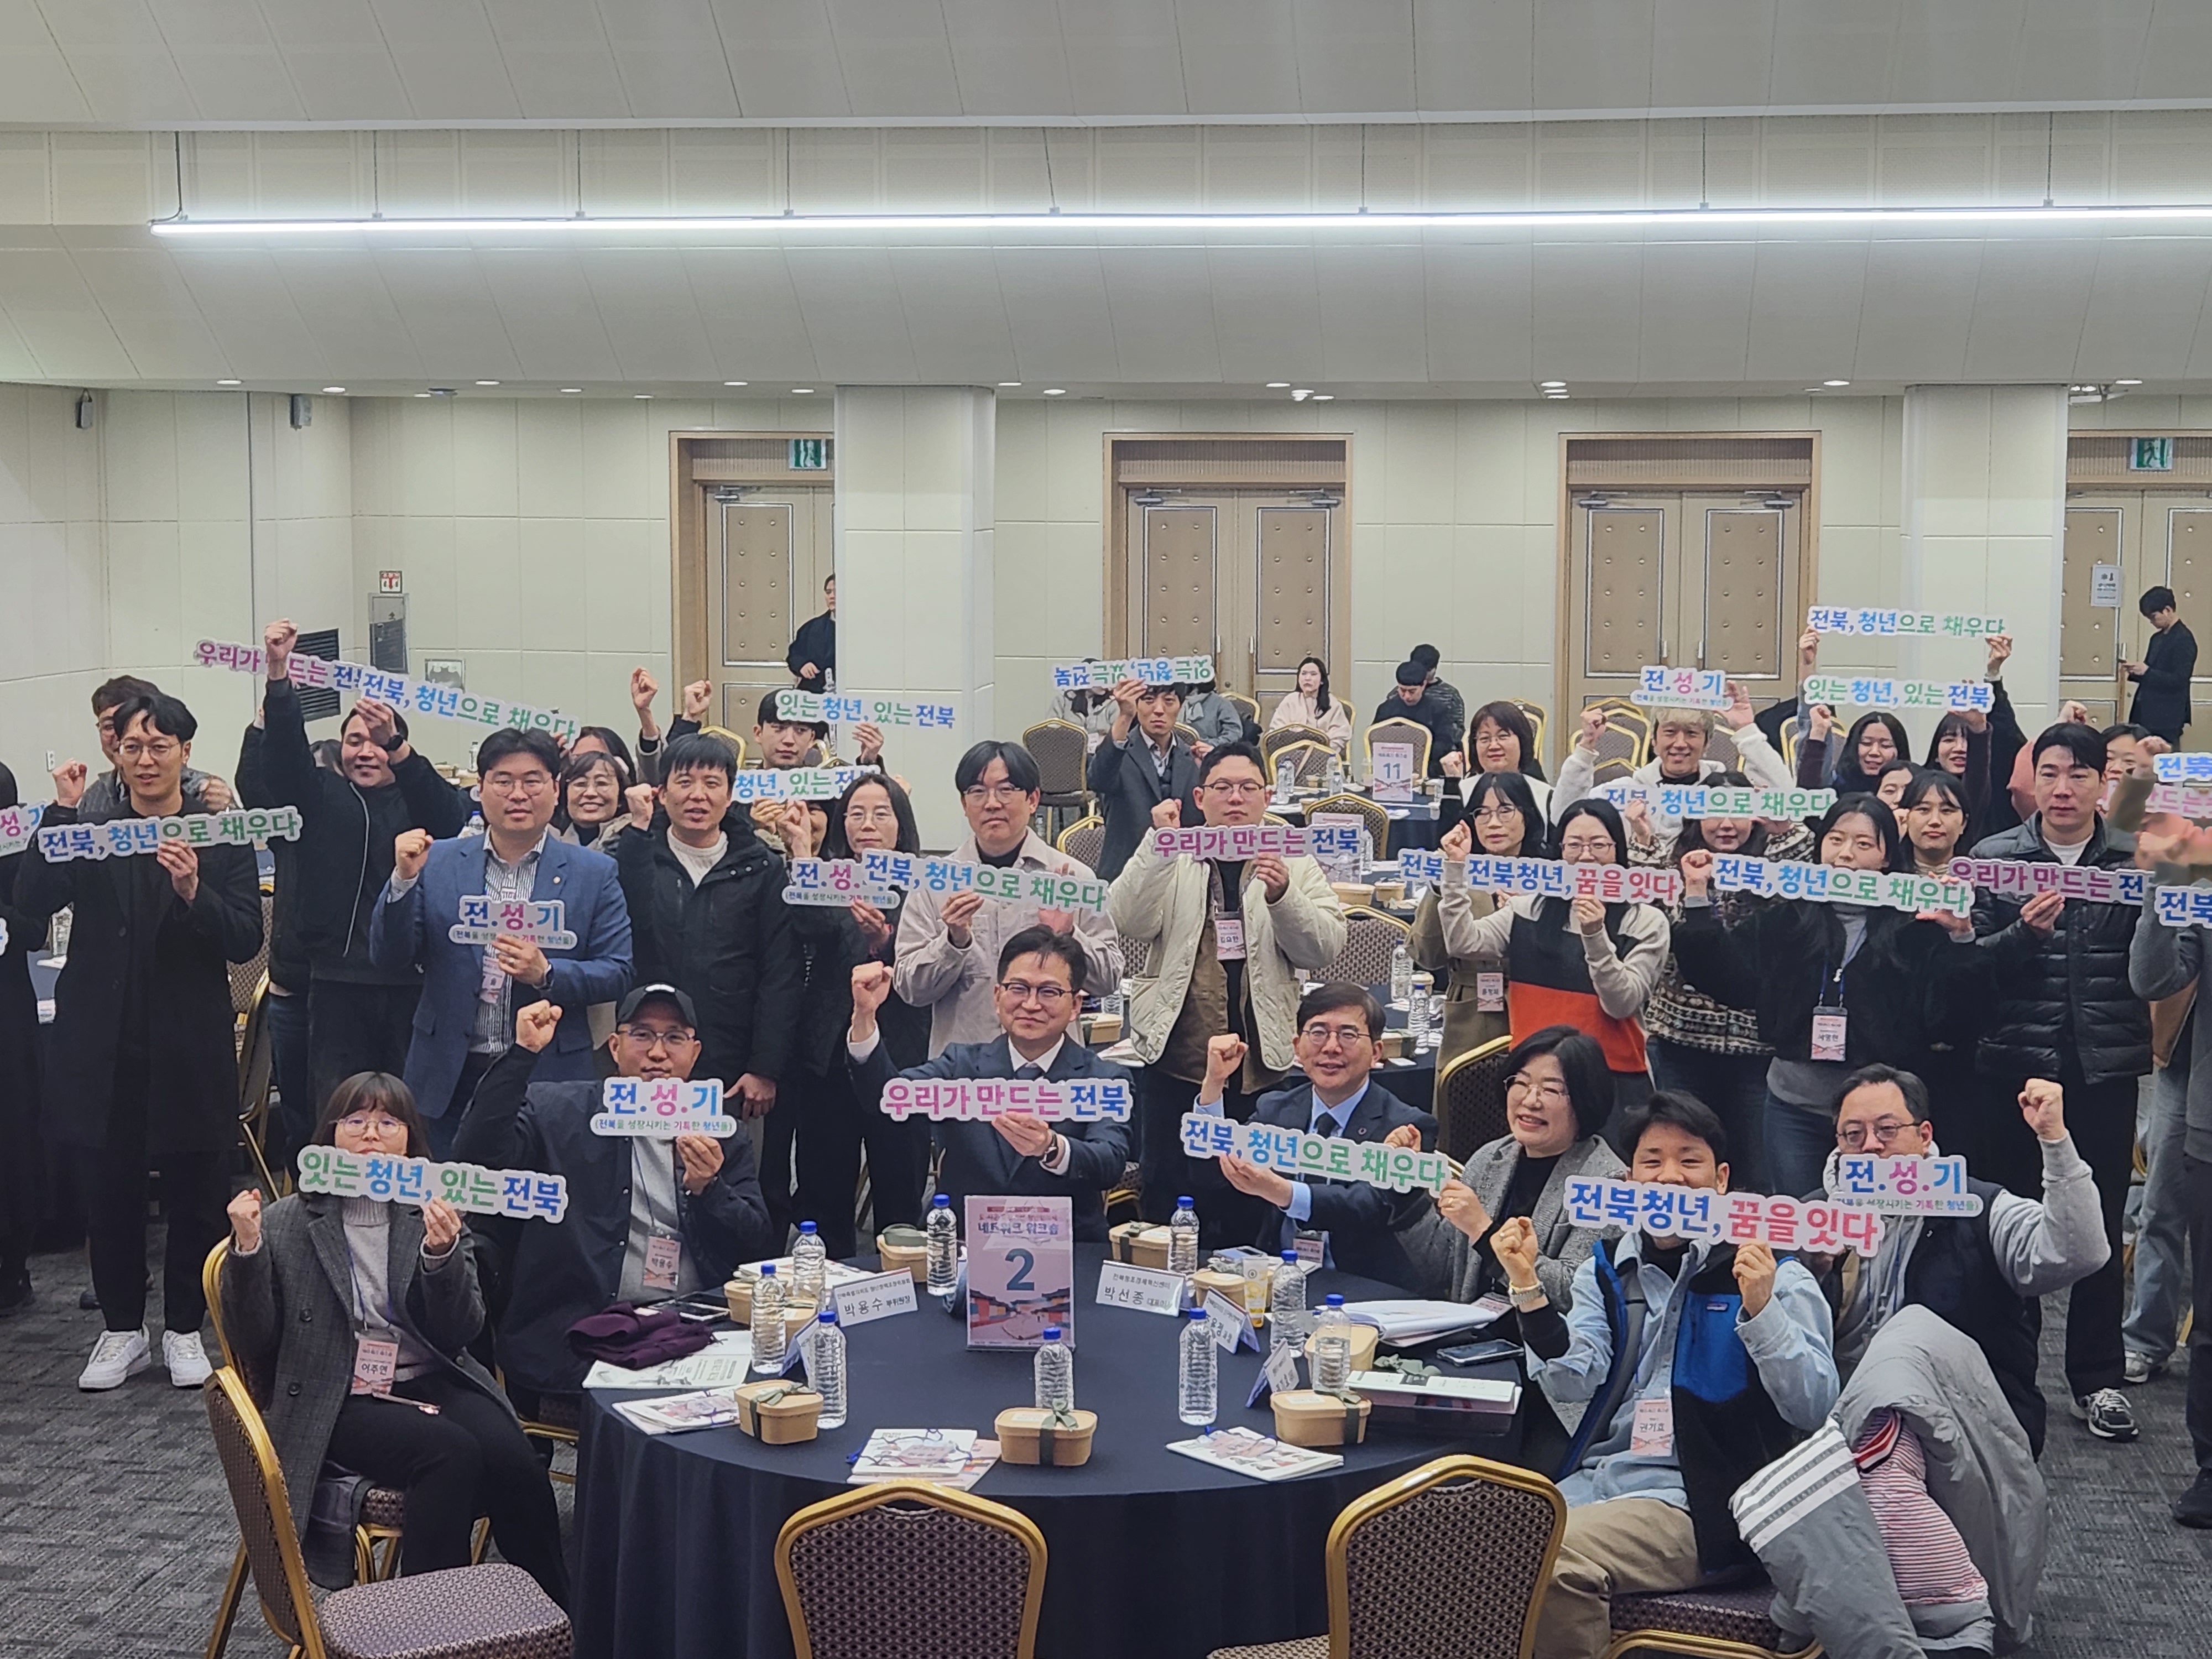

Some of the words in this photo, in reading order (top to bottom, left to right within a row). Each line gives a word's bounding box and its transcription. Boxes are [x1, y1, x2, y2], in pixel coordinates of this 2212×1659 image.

[1811, 609, 1854, 634] 전북,
[1858, 611, 1936, 634] 청년으로
[1942, 615, 2005, 636] 채우다
[199, 641, 260, 672] 우리가
[265, 653, 328, 684] 드는
[333, 665, 361, 690] 전
[1054, 666, 1090, 687] 전북
[1645, 670, 1721, 696] 전.성.기
[1851, 680, 1898, 706] 청년,
[1948, 686, 1990, 708] 전북
[363, 673, 410, 709] 전북,
[415, 685, 499, 726] 청년으로
[507, 707, 576, 745] 채우다
[780, 695, 820, 718] 잇는
[823, 697, 869, 722] 청년,
[874, 702, 912, 725] 있는
[916, 705, 956, 729] 전북
[735, 773, 784, 799] 청년,
[789, 773, 832, 796] 있는
[1383, 763, 1401, 779] 11
[1661, 790, 1754, 817] 청년으로
[1761, 793, 1835, 820] 채우다
[43, 827, 105, 857] 전북,
[109, 823, 211, 851] 청년으로
[220, 814, 298, 842] 채우다
[1155, 831, 1227, 857] 우리가
[1232, 831, 1306, 855] 만드는
[1312, 829, 1360, 854] 전북
[796, 863, 867, 891] 전.성.
[865, 854, 919, 889] 전북,
[925, 864, 1020, 899] 청년으로
[1030, 877, 1105, 912] 채우다
[1468, 858, 1571, 895] 전북청년,
[1575, 868, 1624, 899] 꿈을
[1629, 870, 1678, 901] 잇다
[1716, 858, 1773, 893] 전북,
[1778, 864, 1880, 901] 청년으로
[1889, 877, 1969, 912] 채우다
[2033, 868, 2112, 899] 만드는
[2119, 875, 2143, 900] 전
[464, 901, 559, 931] 전.성.기
[609, 1083, 717, 1116] 전.성.기
[885, 1085, 970, 1115] 우리가
[977, 1085, 1062, 1115] 만드는
[1071, 1085, 1127, 1116] 전북
[1186, 1119, 1242, 1159] 전북,
[1248, 1129, 1352, 1175] 청년으로
[1361, 1147, 1446, 1191] 채우다
[303, 1152, 361, 1191] 잇는
[366, 1159, 432, 1202] 청년,
[441, 1168, 498, 1207] 있는
[503, 1176, 561, 1216] 전북
[1845, 1160, 1960, 1195] 전.성.기
[1569, 1182, 1721, 1239] 전북청년,
[1728, 1198, 1799, 1244] 꿈을
[1806, 1208, 1878, 1252] 잇다
[1004, 1248, 1035, 1291] 2
[844, 1297, 883, 1317] 박용수
